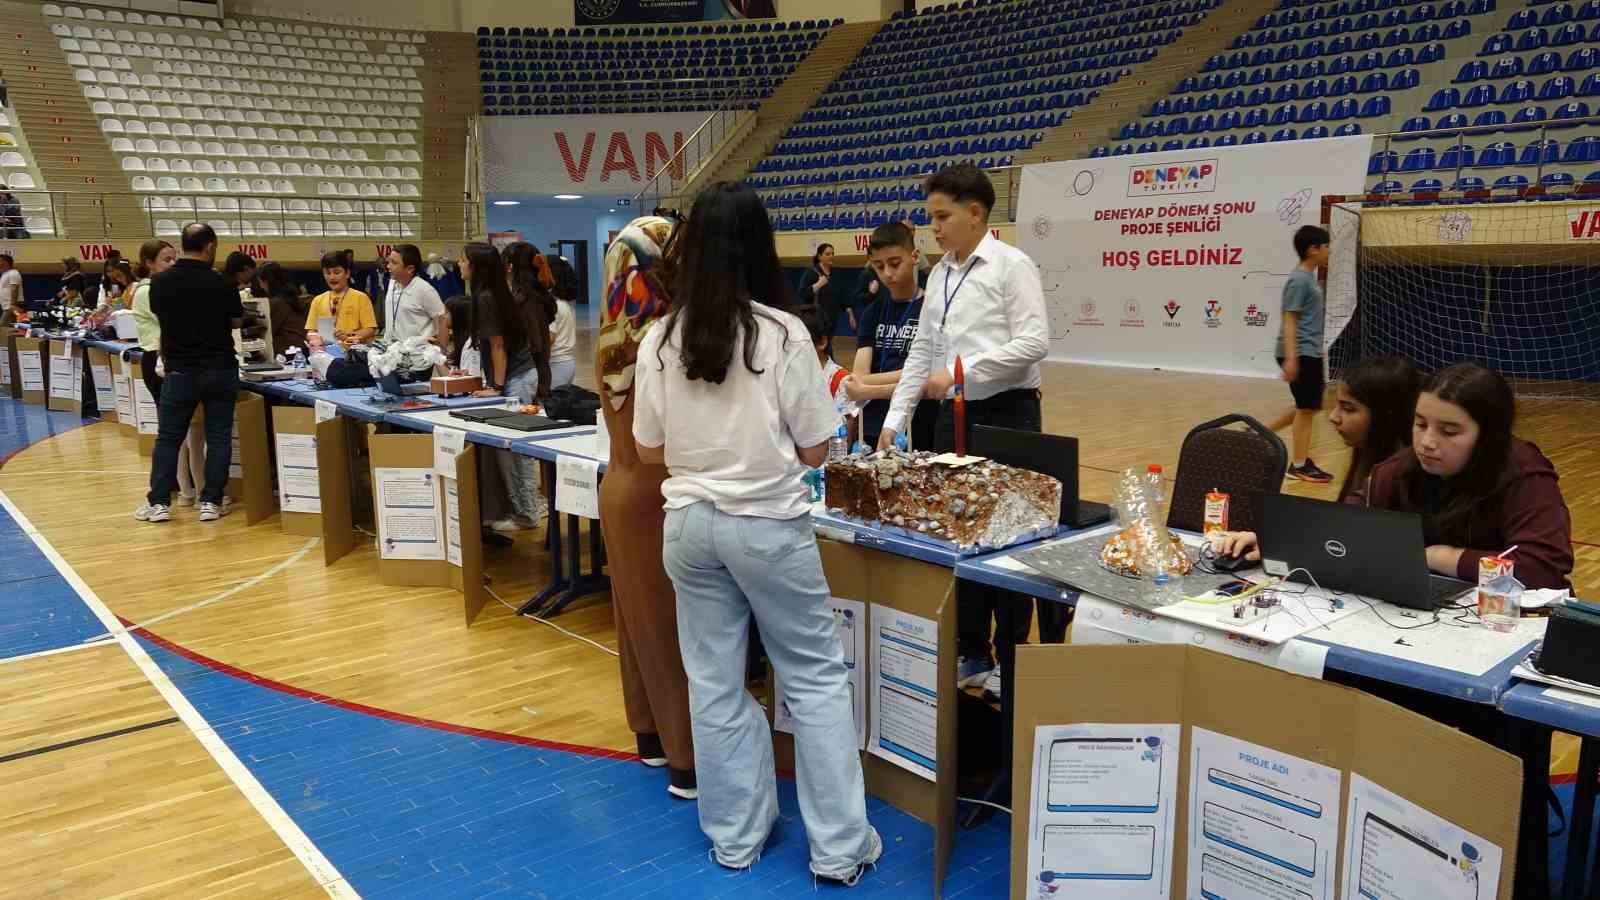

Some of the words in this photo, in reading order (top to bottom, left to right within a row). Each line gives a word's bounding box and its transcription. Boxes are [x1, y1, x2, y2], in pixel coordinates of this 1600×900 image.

[554, 132, 684, 183] VAN
[1133, 164, 1212, 184] DENEYAP
[1094, 207, 1154, 221] DENEYAP
[1157, 202, 1209, 217] DÖNEM
[1213, 201, 1256, 215] SONU
[1120, 222, 1163, 235] PROJE
[1165, 217, 1221, 236] ŞENLİĞİ
[1101, 250, 1141, 271] HOŞ
[1147, 244, 1243, 267] GELDİNİZ
[1239, 752, 1271, 770] PROJE
[1271, 762, 1289, 775] ADI
